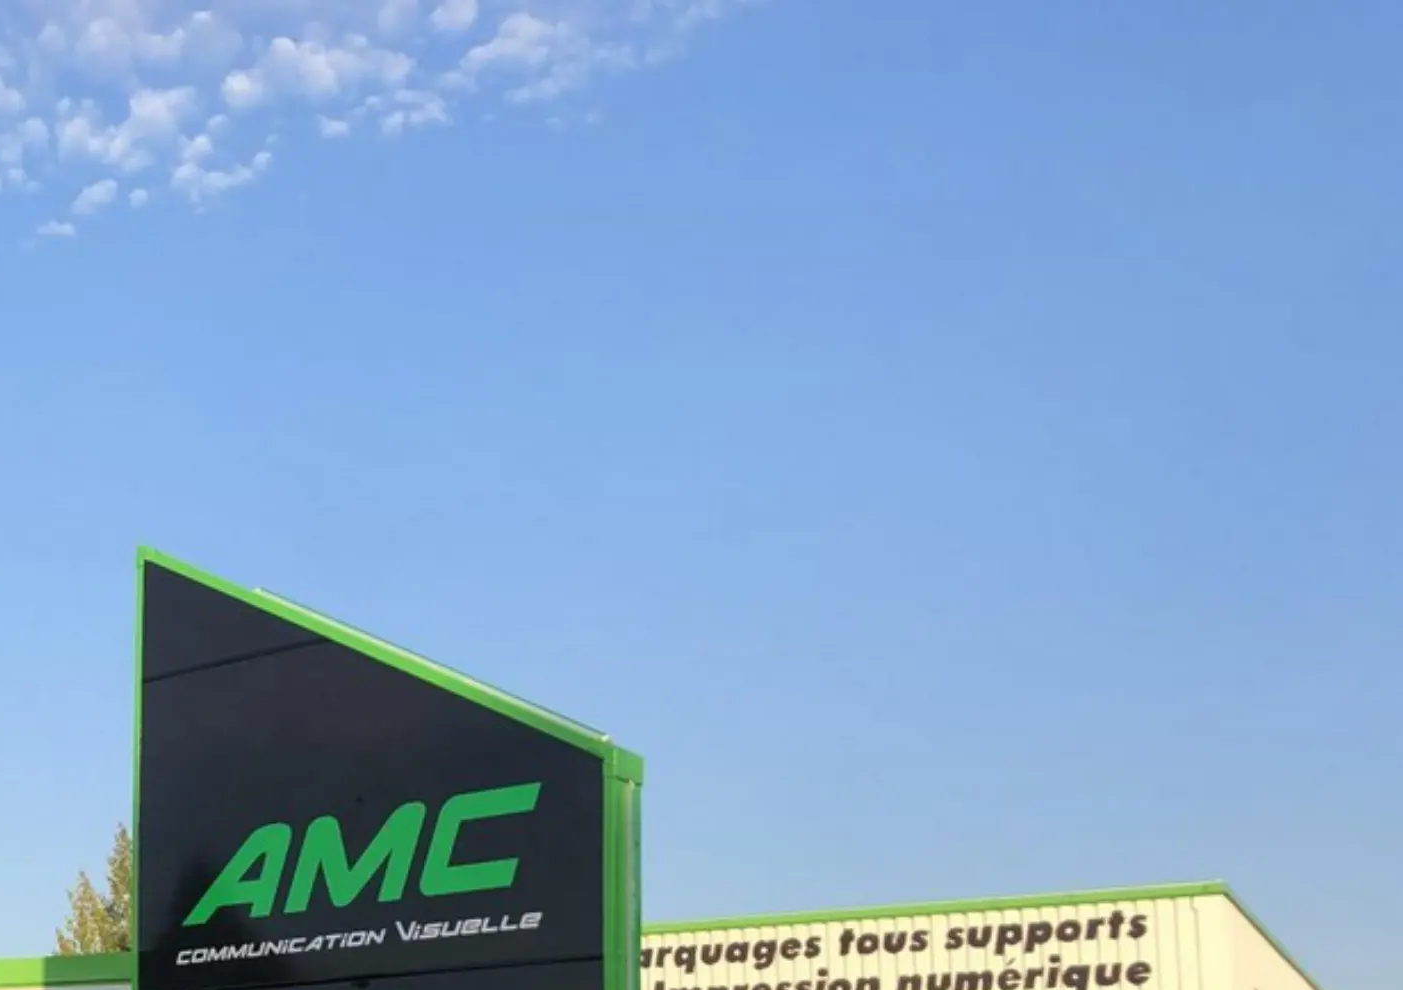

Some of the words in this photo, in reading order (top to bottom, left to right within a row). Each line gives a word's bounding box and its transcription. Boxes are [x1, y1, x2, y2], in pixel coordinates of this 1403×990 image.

[182, 782, 541, 926] AMC
[640, 935, 822, 974] arquages
[839, 928, 929, 956] tous
[944, 910, 1147, 955] supports
